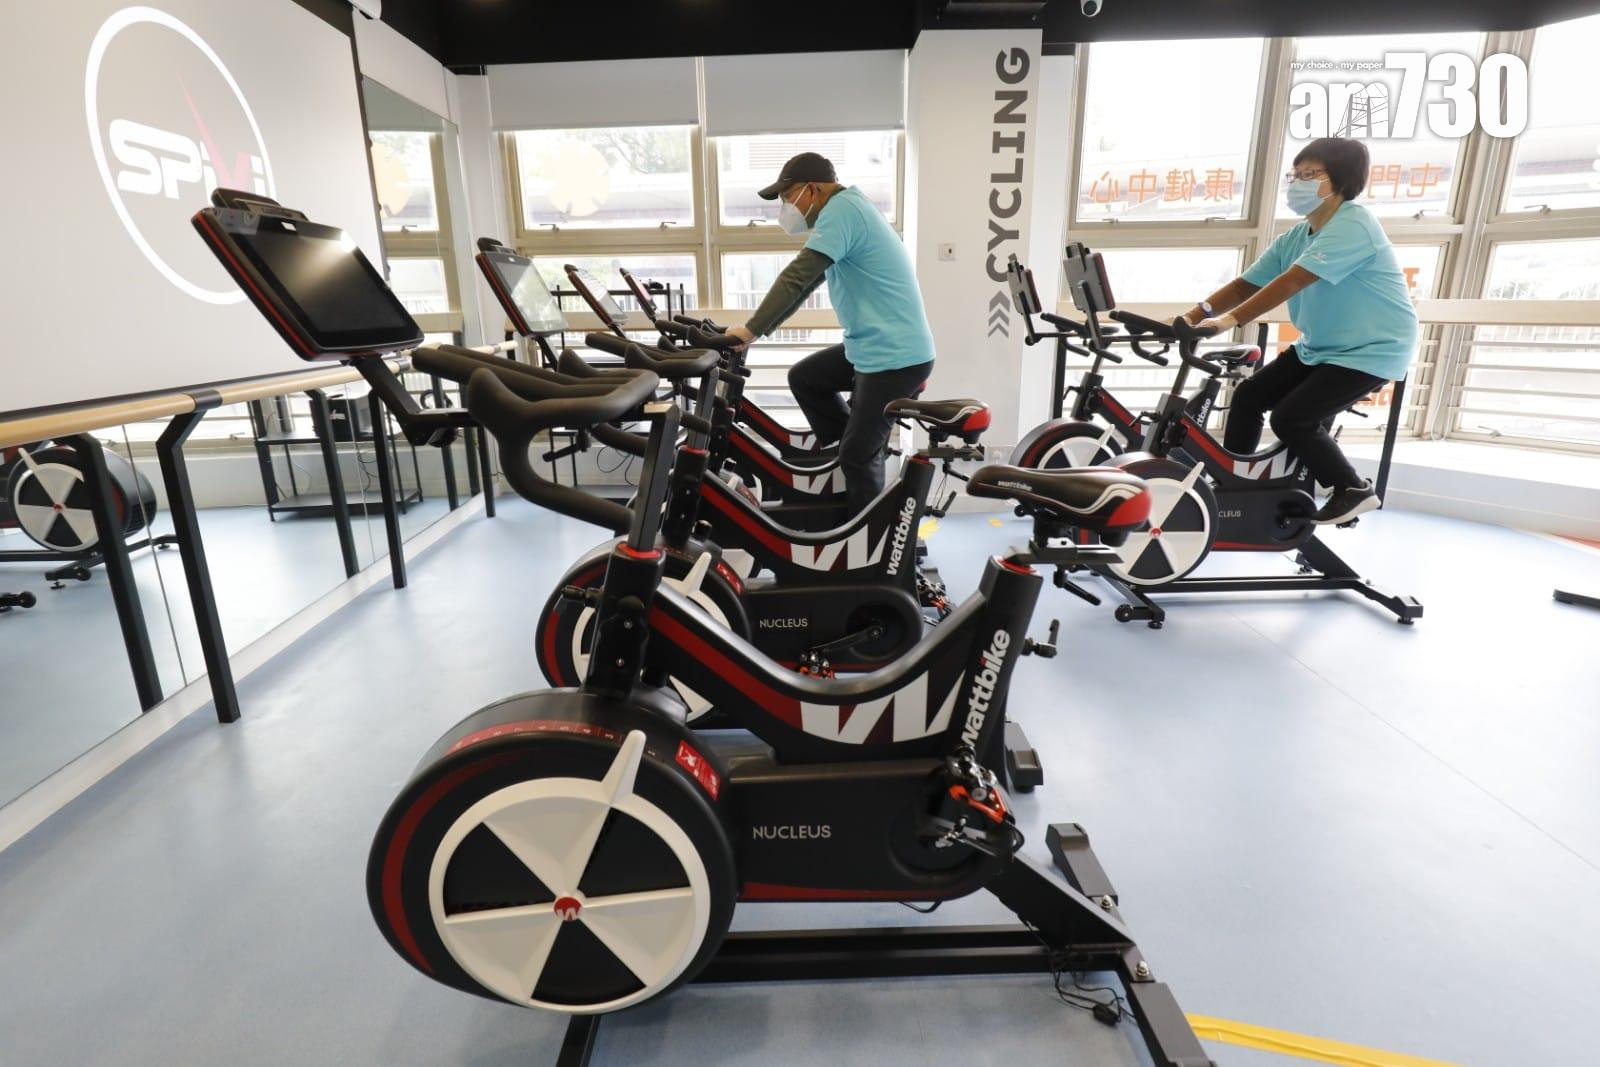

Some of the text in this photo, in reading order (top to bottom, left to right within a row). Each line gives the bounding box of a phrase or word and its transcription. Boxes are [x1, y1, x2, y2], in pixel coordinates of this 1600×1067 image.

[986, 47, 1030, 282] CYCLING
[886, 497, 917, 575] wattbike
[1219, 510, 1241, 518] CLEUS
[759, 617, 808, 628] NUCLEUS
[961, 629, 1011, 748] wattbike
[752, 825, 831, 839] NUCLEUS
